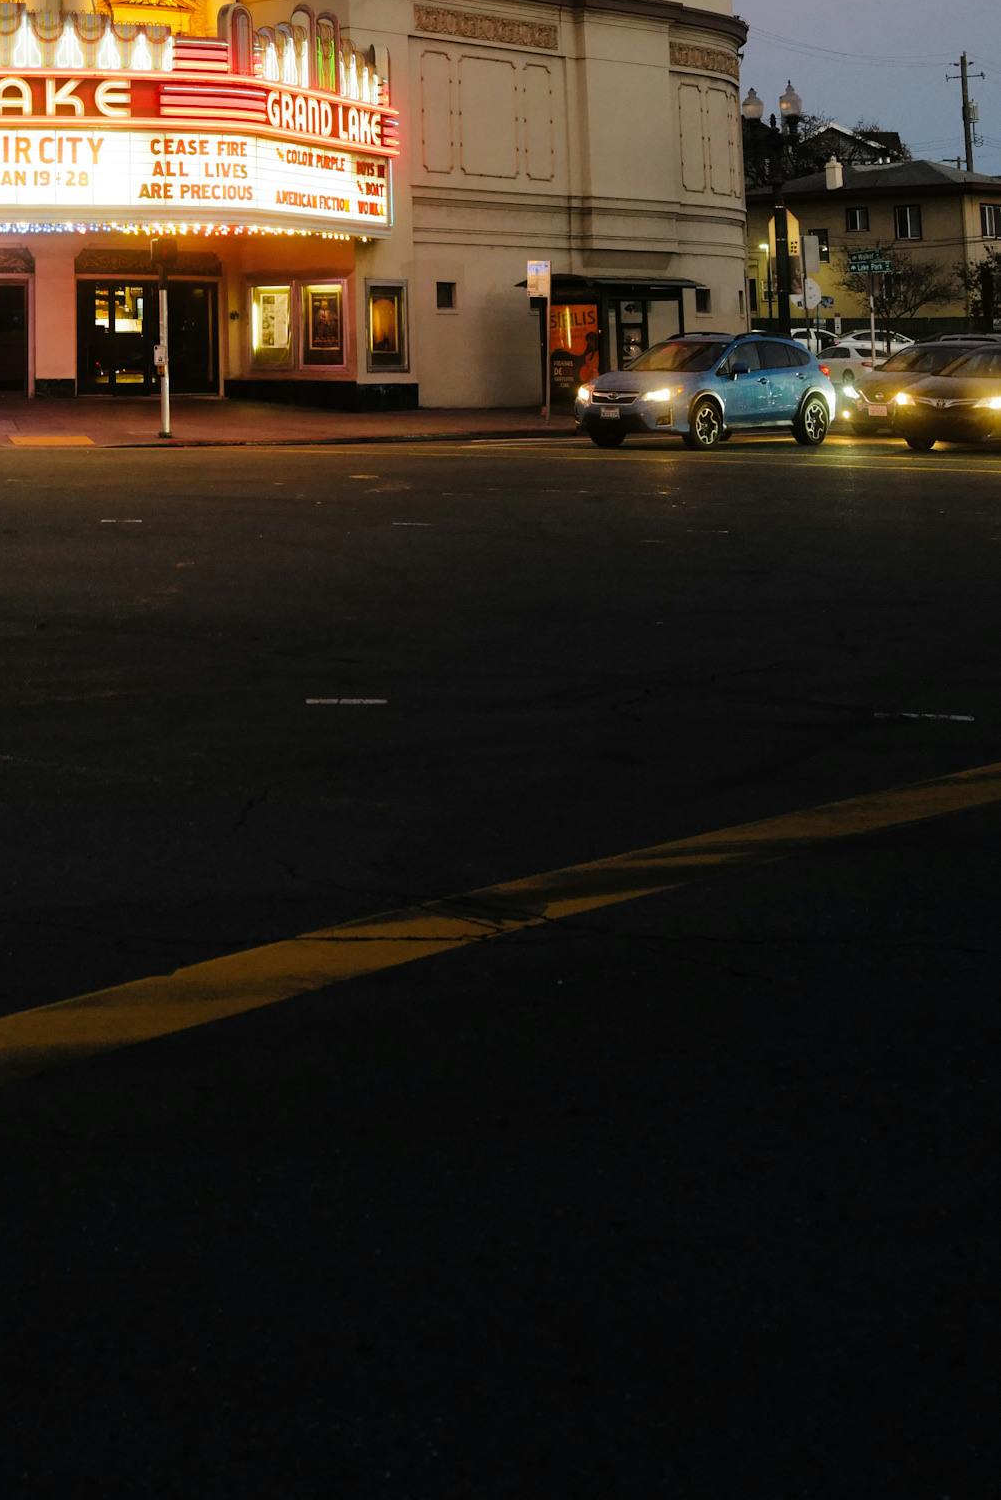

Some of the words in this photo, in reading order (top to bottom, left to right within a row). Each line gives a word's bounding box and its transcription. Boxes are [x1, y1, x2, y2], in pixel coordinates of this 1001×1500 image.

[267, 90, 332, 137] GRAND
[339, 104, 382, 146] LAKE
[38, 136, 104, 164] CITY
[150, 138, 210, 155] CEASE
[216, 140, 248, 157] FIRE
[152, 161, 189, 177] ALL
[204, 162, 248, 179] LIVES
[286, 149, 313, 167] COLOR
[316, 154, 346, 172] PURPLE
[138, 183, 174, 199] ARE
[180, 184, 253, 200] PRECIOUS
[275, 190, 318, 209] AMERICAN
[319, 195, 350, 213] FICTION
